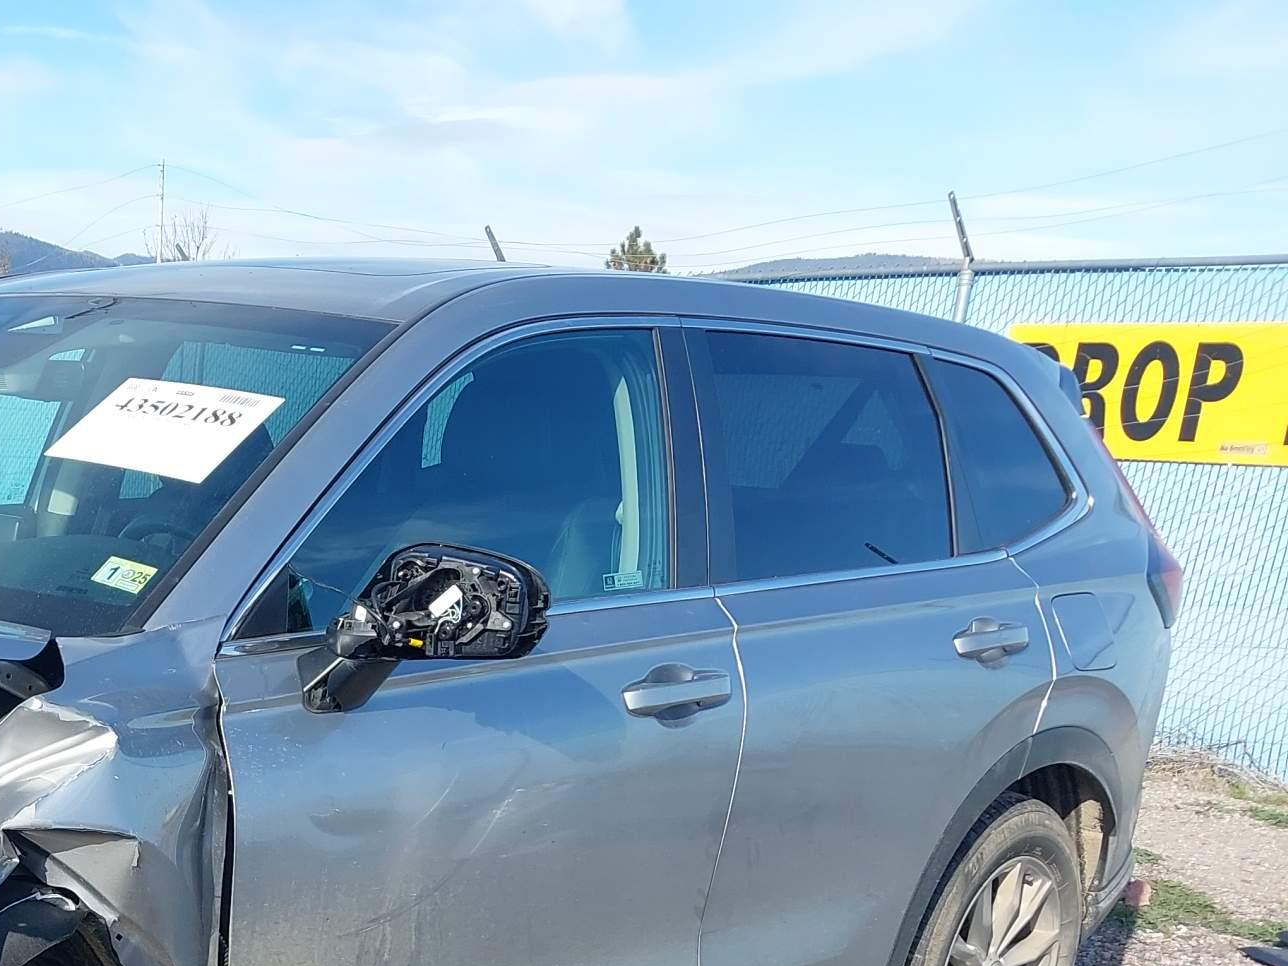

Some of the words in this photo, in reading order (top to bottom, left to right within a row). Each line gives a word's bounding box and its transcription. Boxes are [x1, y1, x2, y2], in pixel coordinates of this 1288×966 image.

[1022, 340, 1245, 442] ROP
[115, 396, 243, 427] 43502188
[106, 565, 121, 580] 1
[130, 571, 152, 585] 25
